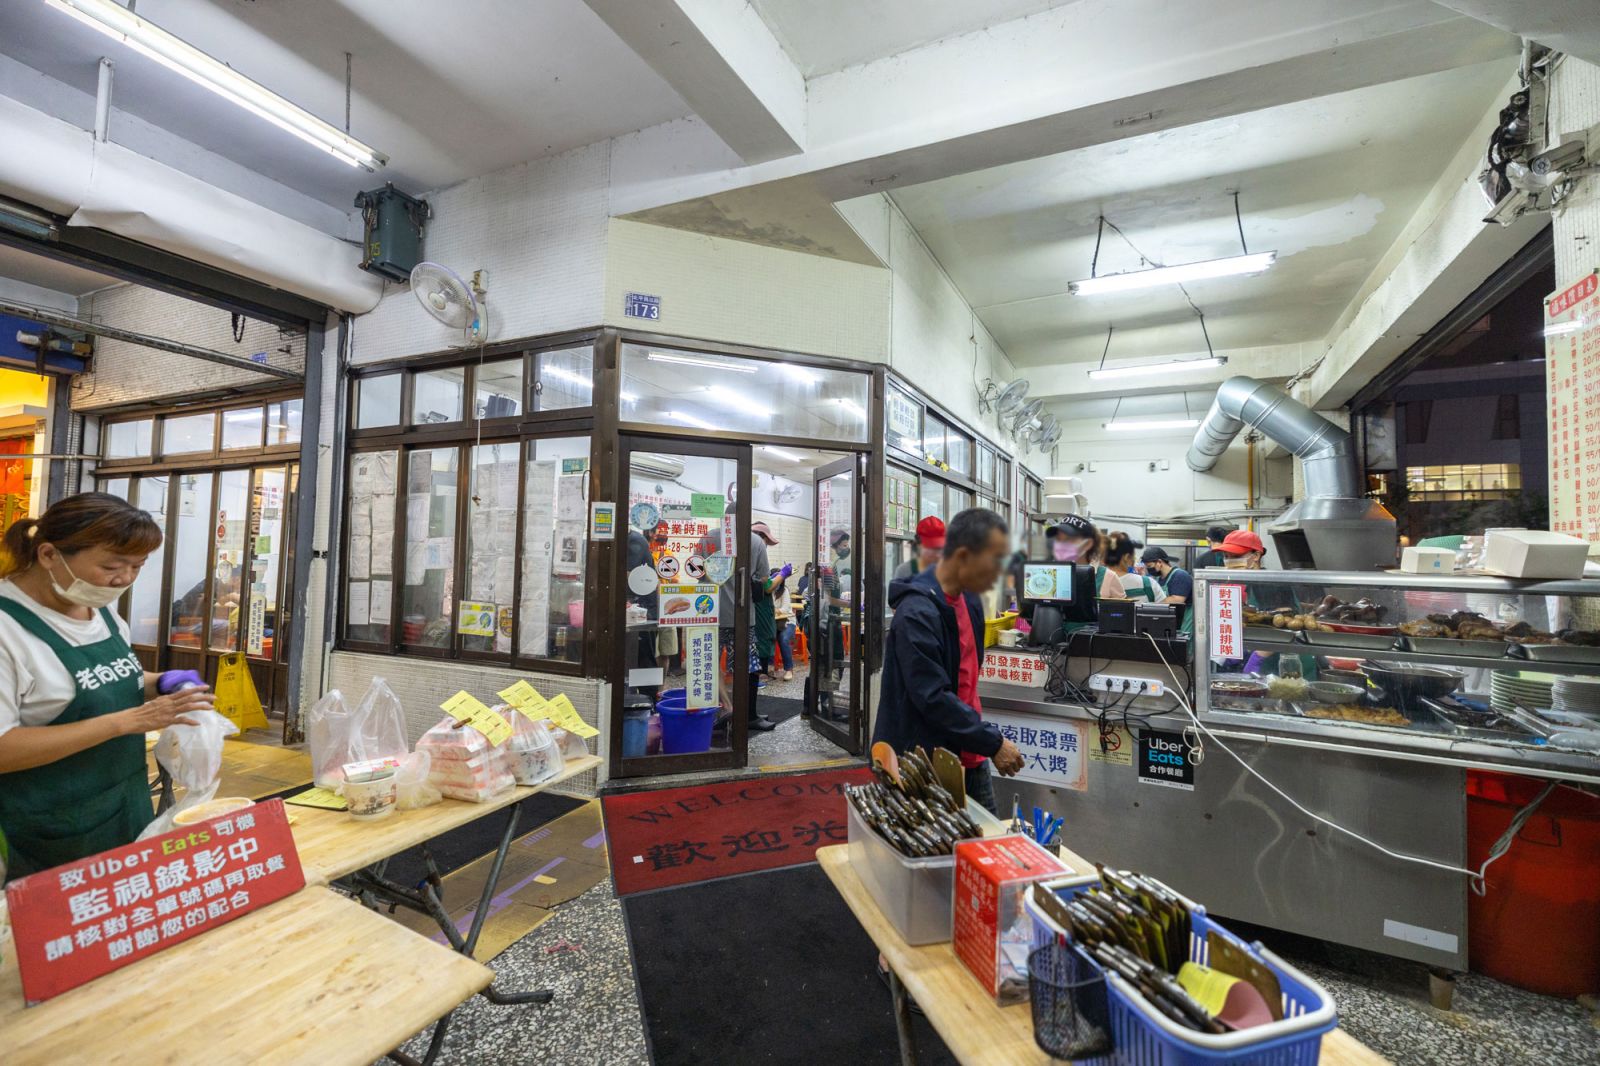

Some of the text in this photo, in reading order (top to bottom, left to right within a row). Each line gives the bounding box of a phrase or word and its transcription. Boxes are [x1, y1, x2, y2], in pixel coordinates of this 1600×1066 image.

[633, 303, 658, 319] 173
[657, 523, 708, 536] 營業時間
[985, 654, 1046, 672] 和發票金額
[991, 723, 1078, 752] 索取發票
[1149, 737, 1183, 752] Uber
[1020, 752, 1068, 775] 大獎
[1149, 749, 1184, 765] Eats
[625, 782, 845, 825] WELCOM
[58, 813, 256, 891] 致 Uber Eats 司機
[645, 820, 848, 871] 歡迎光
[68, 837, 258, 926] 監視錄影中
[44, 854, 286, 961] 請核對全單號碼再取餐
[108, 890, 250, 960] 謝謝您的配合
